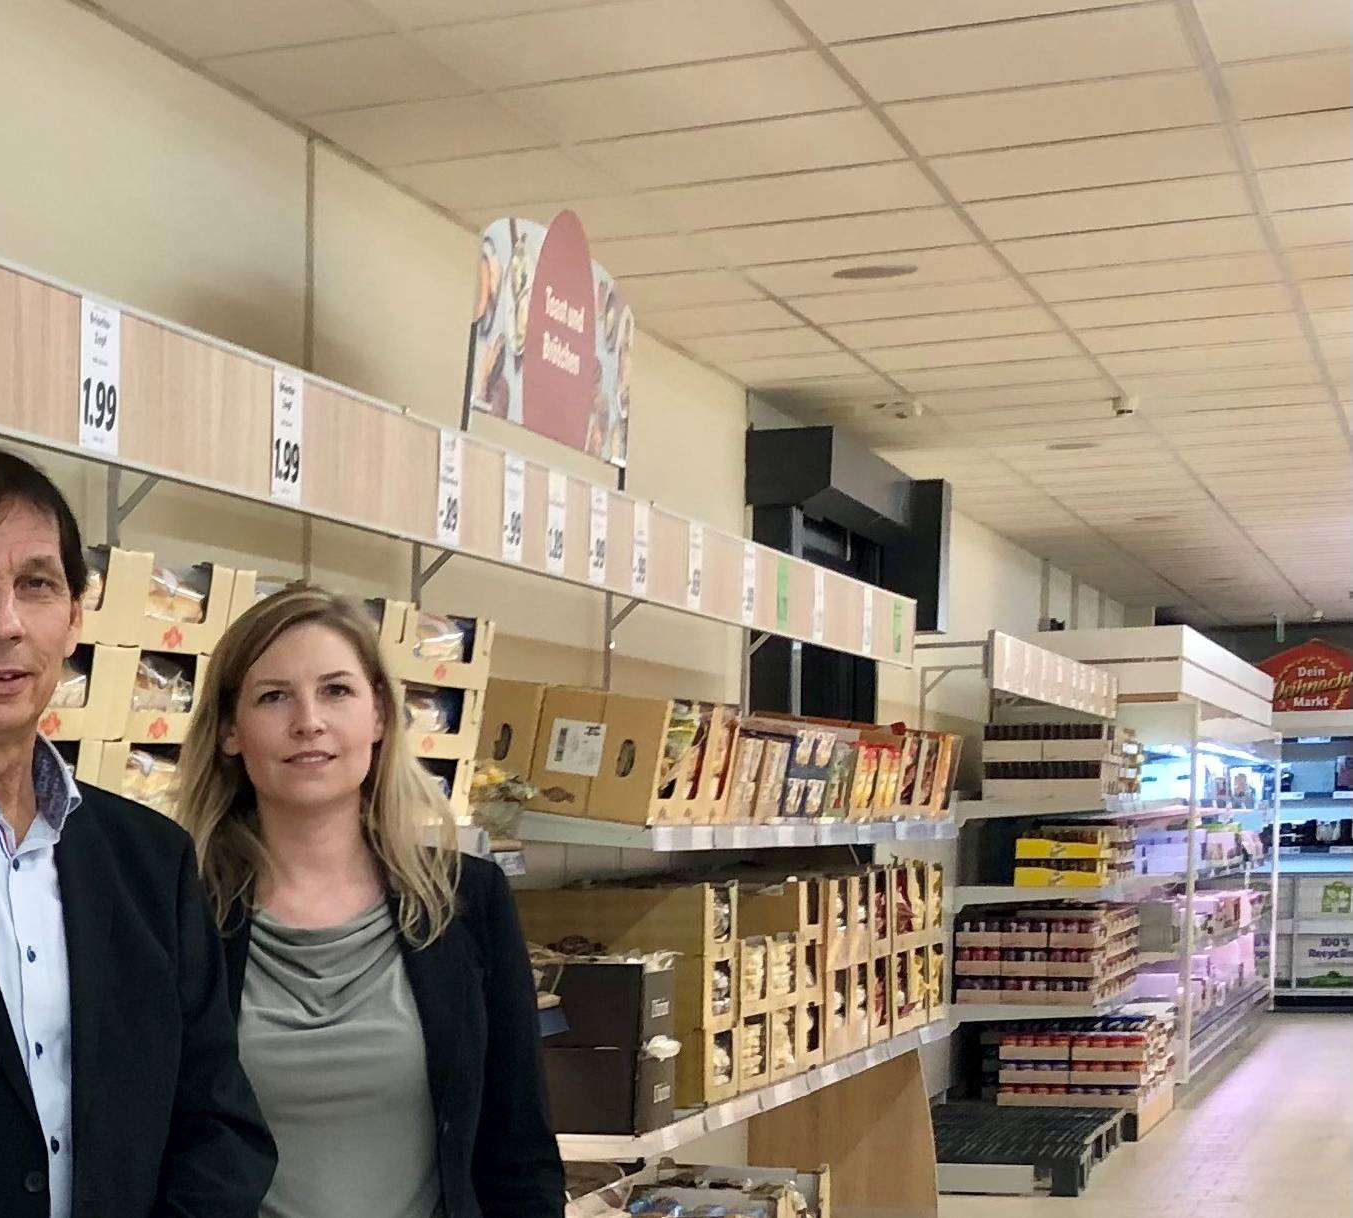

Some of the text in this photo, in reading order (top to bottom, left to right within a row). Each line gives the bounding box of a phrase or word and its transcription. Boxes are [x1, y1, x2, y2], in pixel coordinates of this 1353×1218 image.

[83, 377, 117, 432] 1.99
[275, 438, 300, 483] 1.99
[1297, 666, 1326, 677] Dein
[1293, 696, 1329, 707] Markt
[1321, 937, 1340, 947] 100
